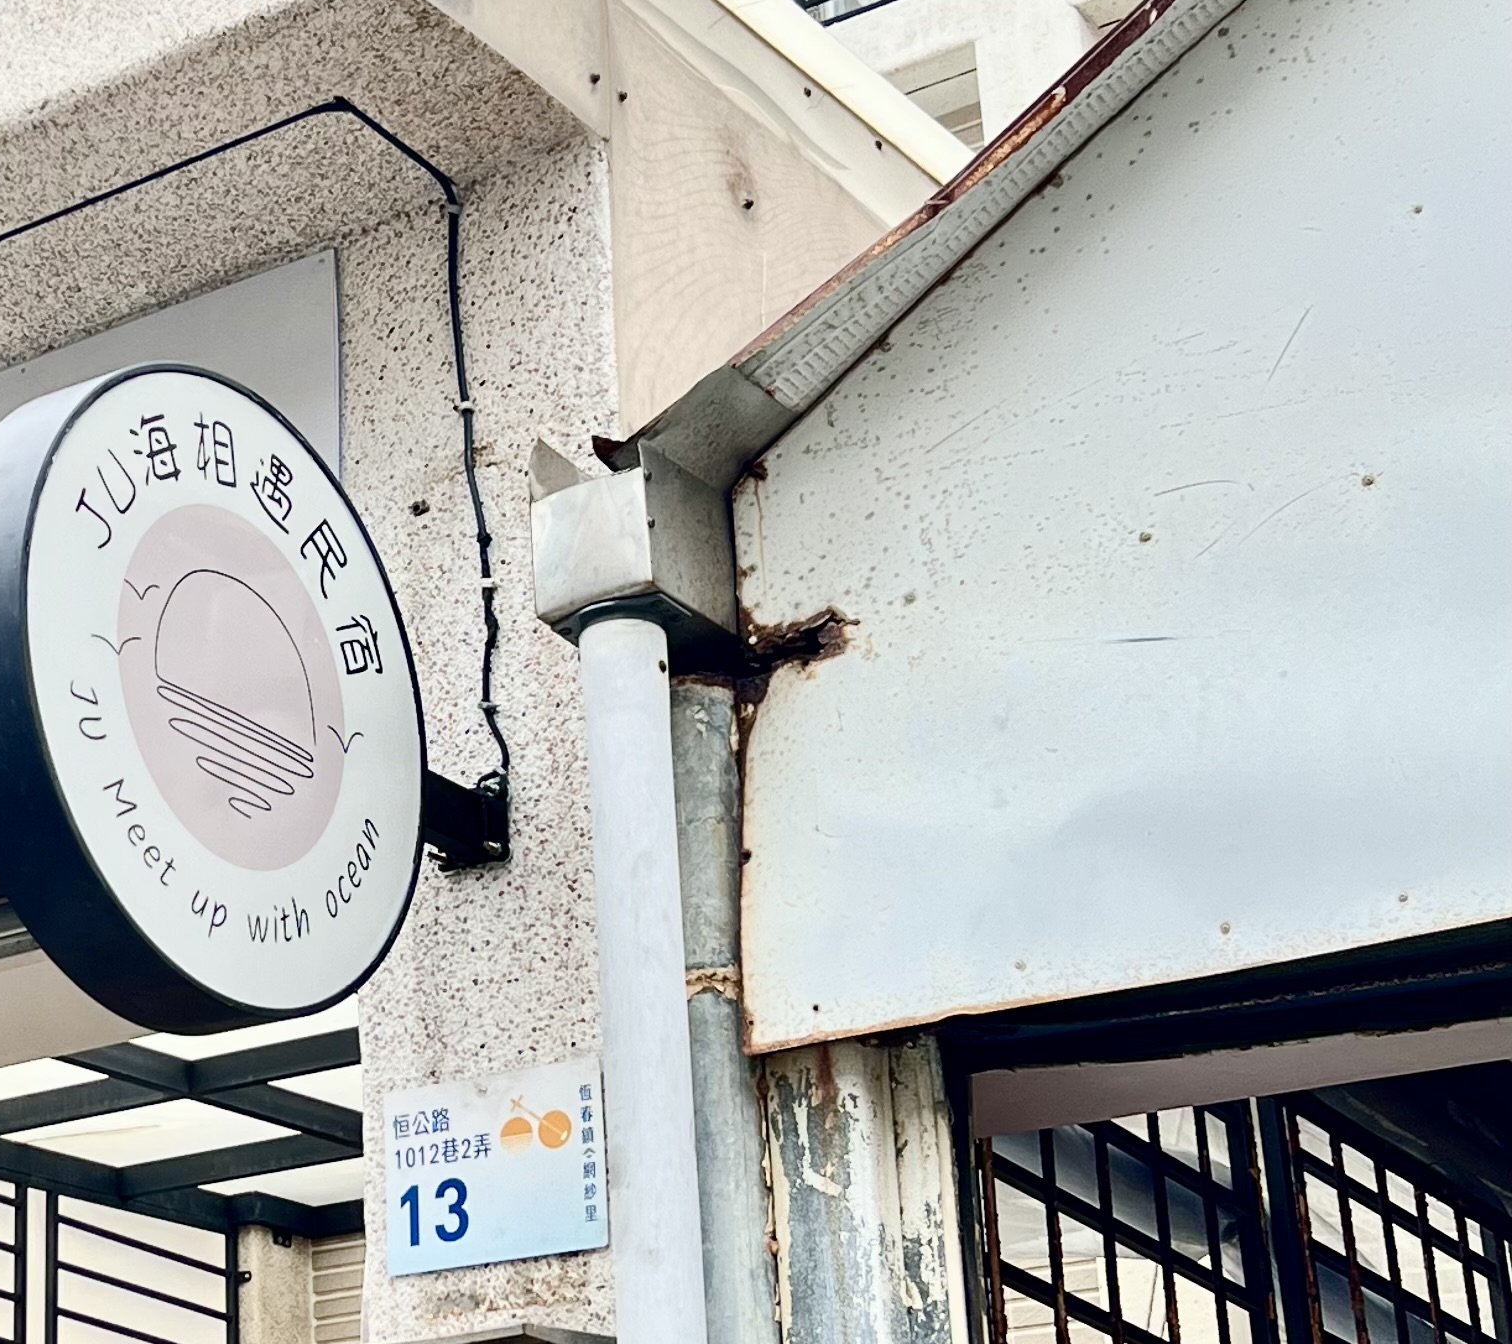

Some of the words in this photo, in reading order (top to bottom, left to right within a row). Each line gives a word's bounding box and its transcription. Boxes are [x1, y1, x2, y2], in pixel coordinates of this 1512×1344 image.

[103, 778, 175, 887] Meet
[191, 890, 228, 938] up
[248, 898, 310, 945] with
[326, 817, 380, 918] ocean
[395, 1133, 491, 1170] 1012巷2弄
[400, 1177, 470, 1247] 13
